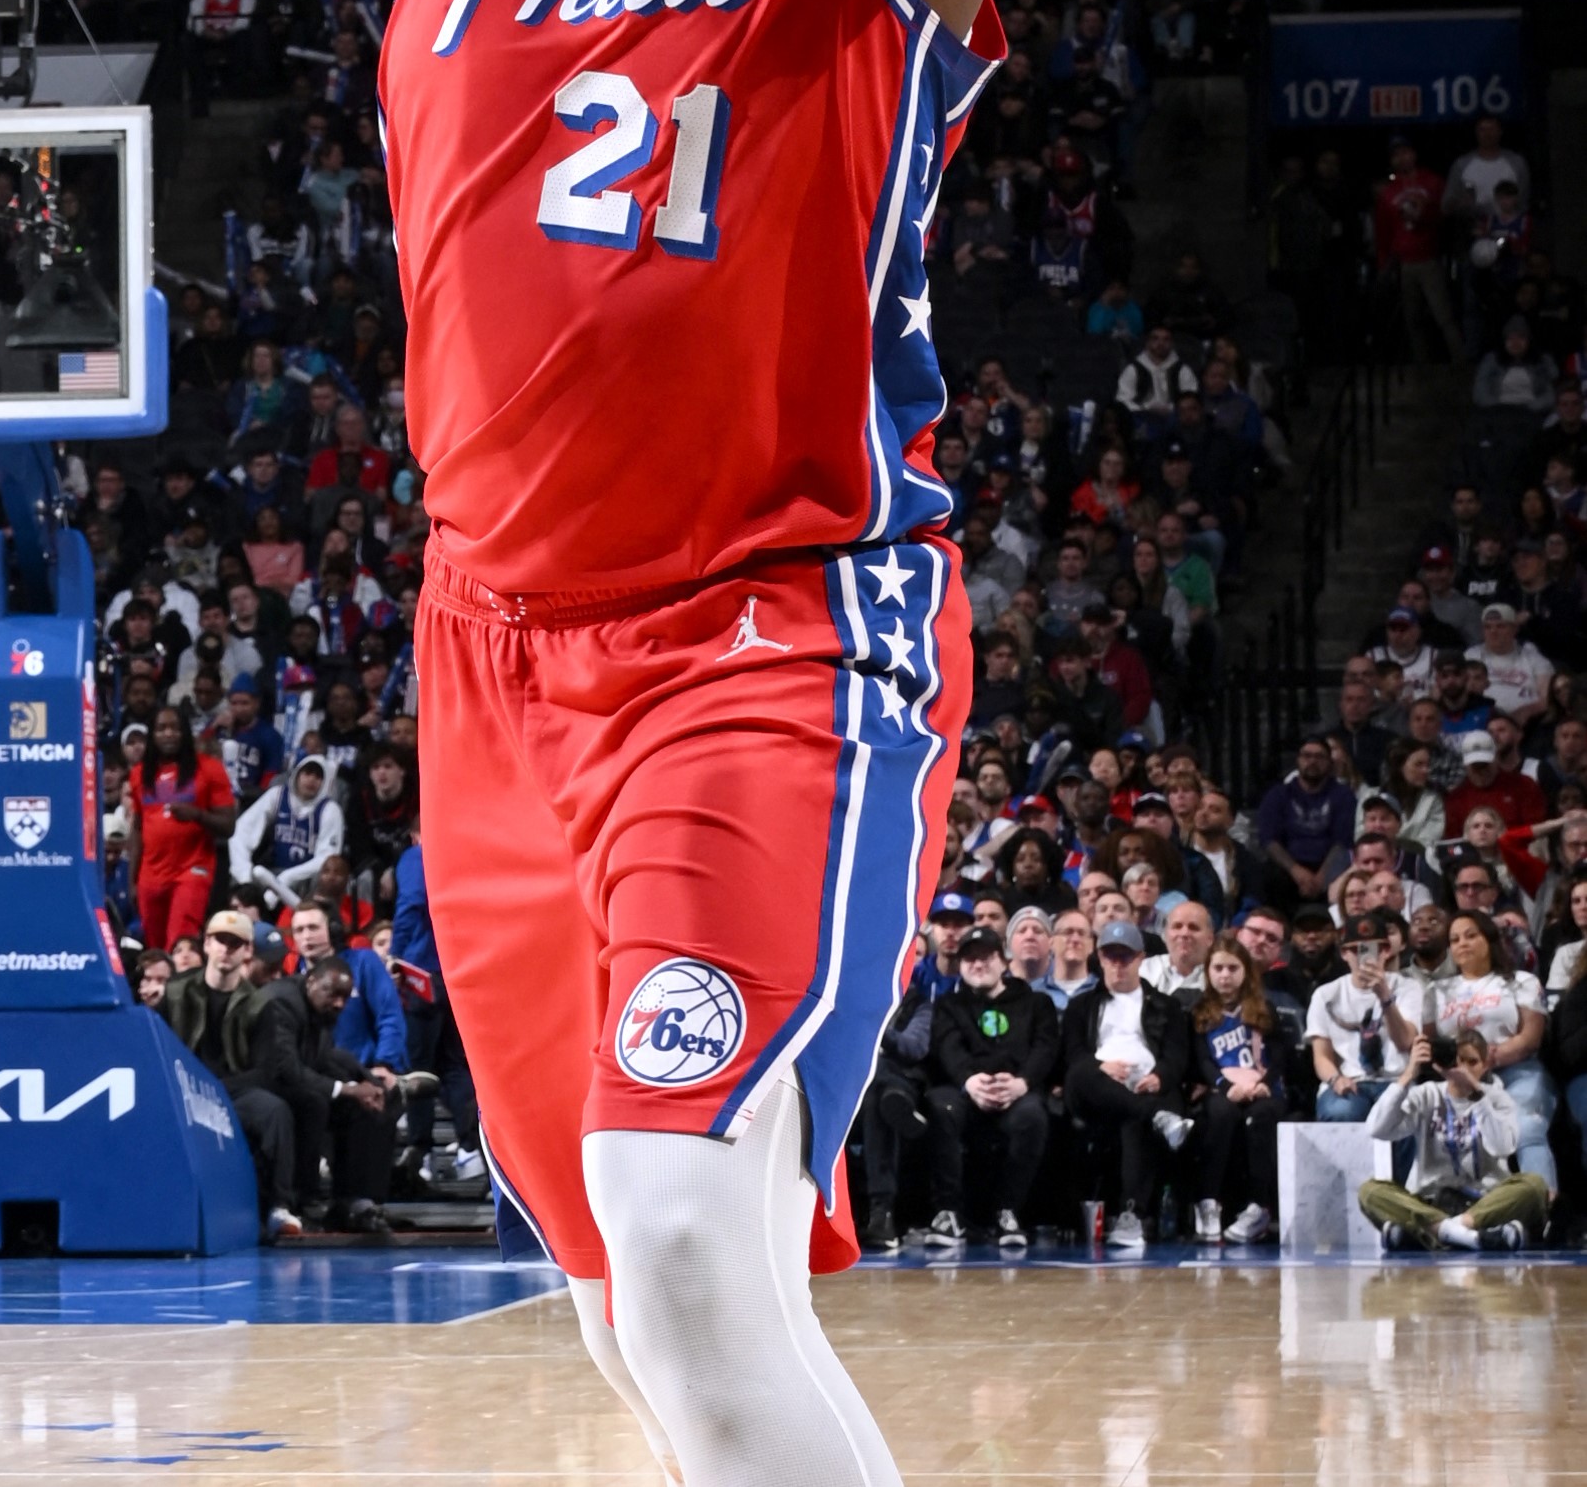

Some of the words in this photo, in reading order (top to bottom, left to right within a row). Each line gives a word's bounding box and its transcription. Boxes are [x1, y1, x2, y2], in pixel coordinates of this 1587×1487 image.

[1282, 78, 1361, 120] 107
[1430, 73, 1511, 116] 106
[536, 70, 732, 261] 21
[10, 647, 45, 677] 76
[625, 1007, 726, 1059] 76ers
[1212, 1024, 1265, 1060] PHIL
